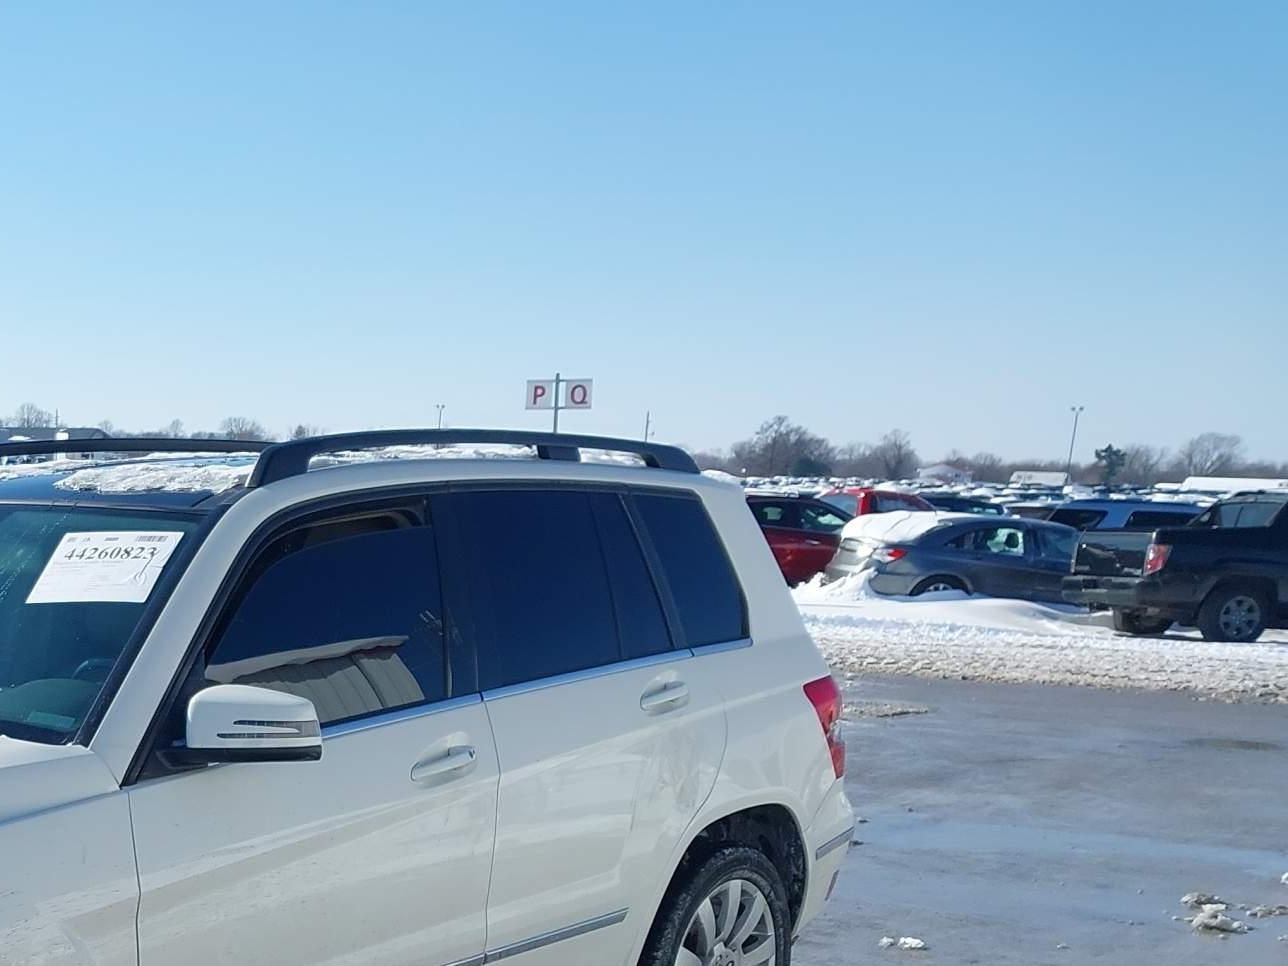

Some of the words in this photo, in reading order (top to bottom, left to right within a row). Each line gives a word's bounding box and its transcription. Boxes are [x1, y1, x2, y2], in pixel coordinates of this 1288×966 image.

[533, 385, 546, 405] P
[571, 384, 588, 405] Q
[64, 546, 158, 561] 44260823
